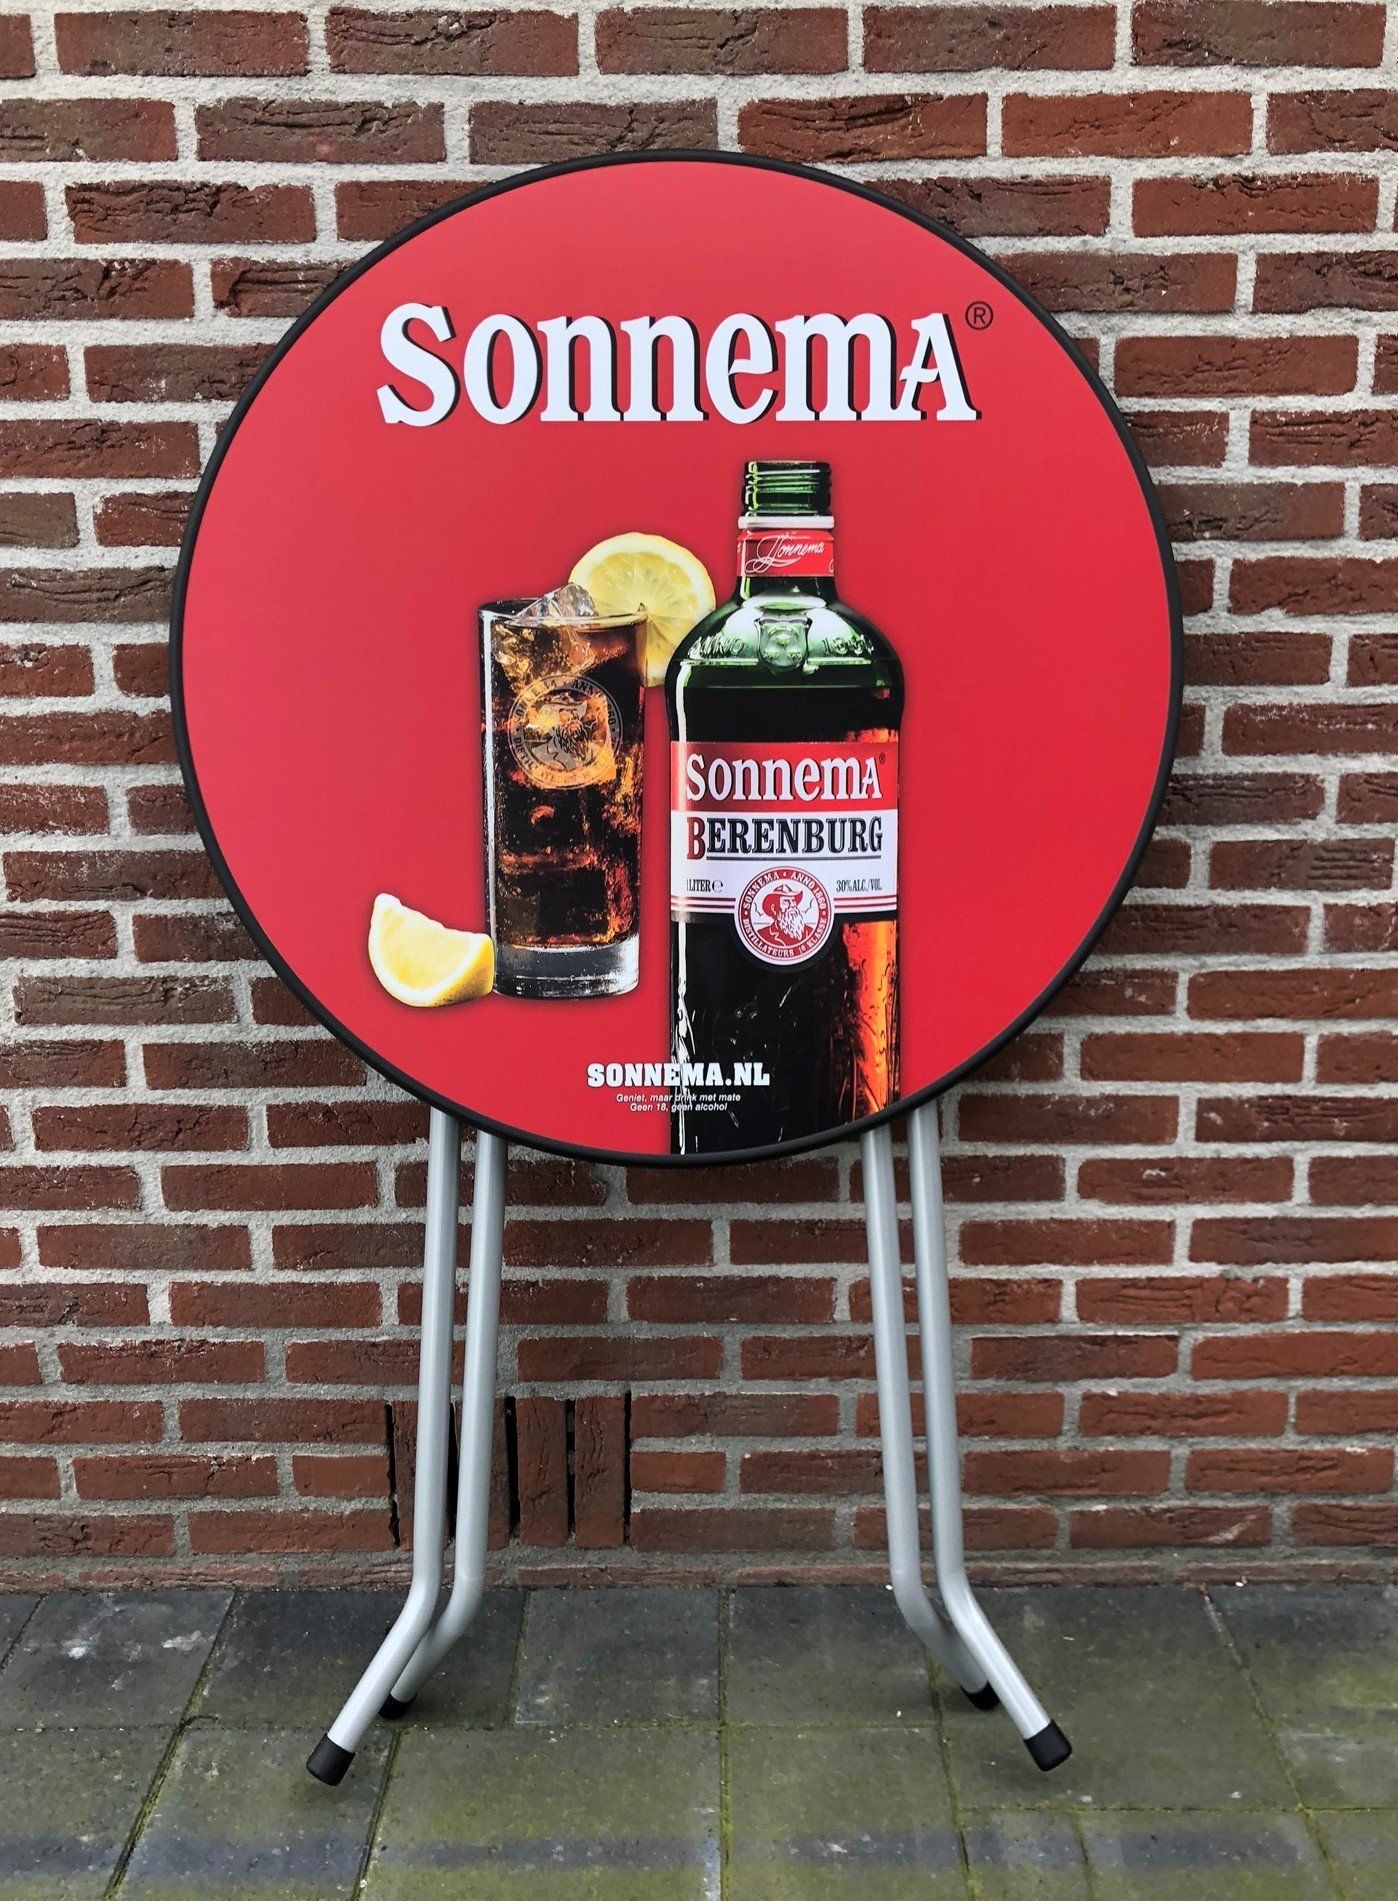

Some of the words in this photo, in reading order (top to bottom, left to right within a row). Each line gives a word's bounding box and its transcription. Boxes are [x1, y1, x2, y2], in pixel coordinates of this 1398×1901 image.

[686, 816, 883, 861] BERENBURG
[742, 871, 780, 910] SONNEMA
[790, 870, 815, 890] ANNO
[742, 918, 795, 958] DISTILLATEURS
[808, 917, 828, 949] KLASSE
[586, 1062, 771, 1088] SONNEMA.NL
[616, 1093, 648, 1103] Geniet,
[674, 1093, 697, 1102] drink
[699, 1094, 716, 1102] met
[718, 1094, 742, 1102] mate
[630, 1103, 653, 1112] Geen
[657, 1103, 669, 1112] 18,
[671, 1104, 693, 1113] geen
[695, 1102, 728, 1111] alcohol
